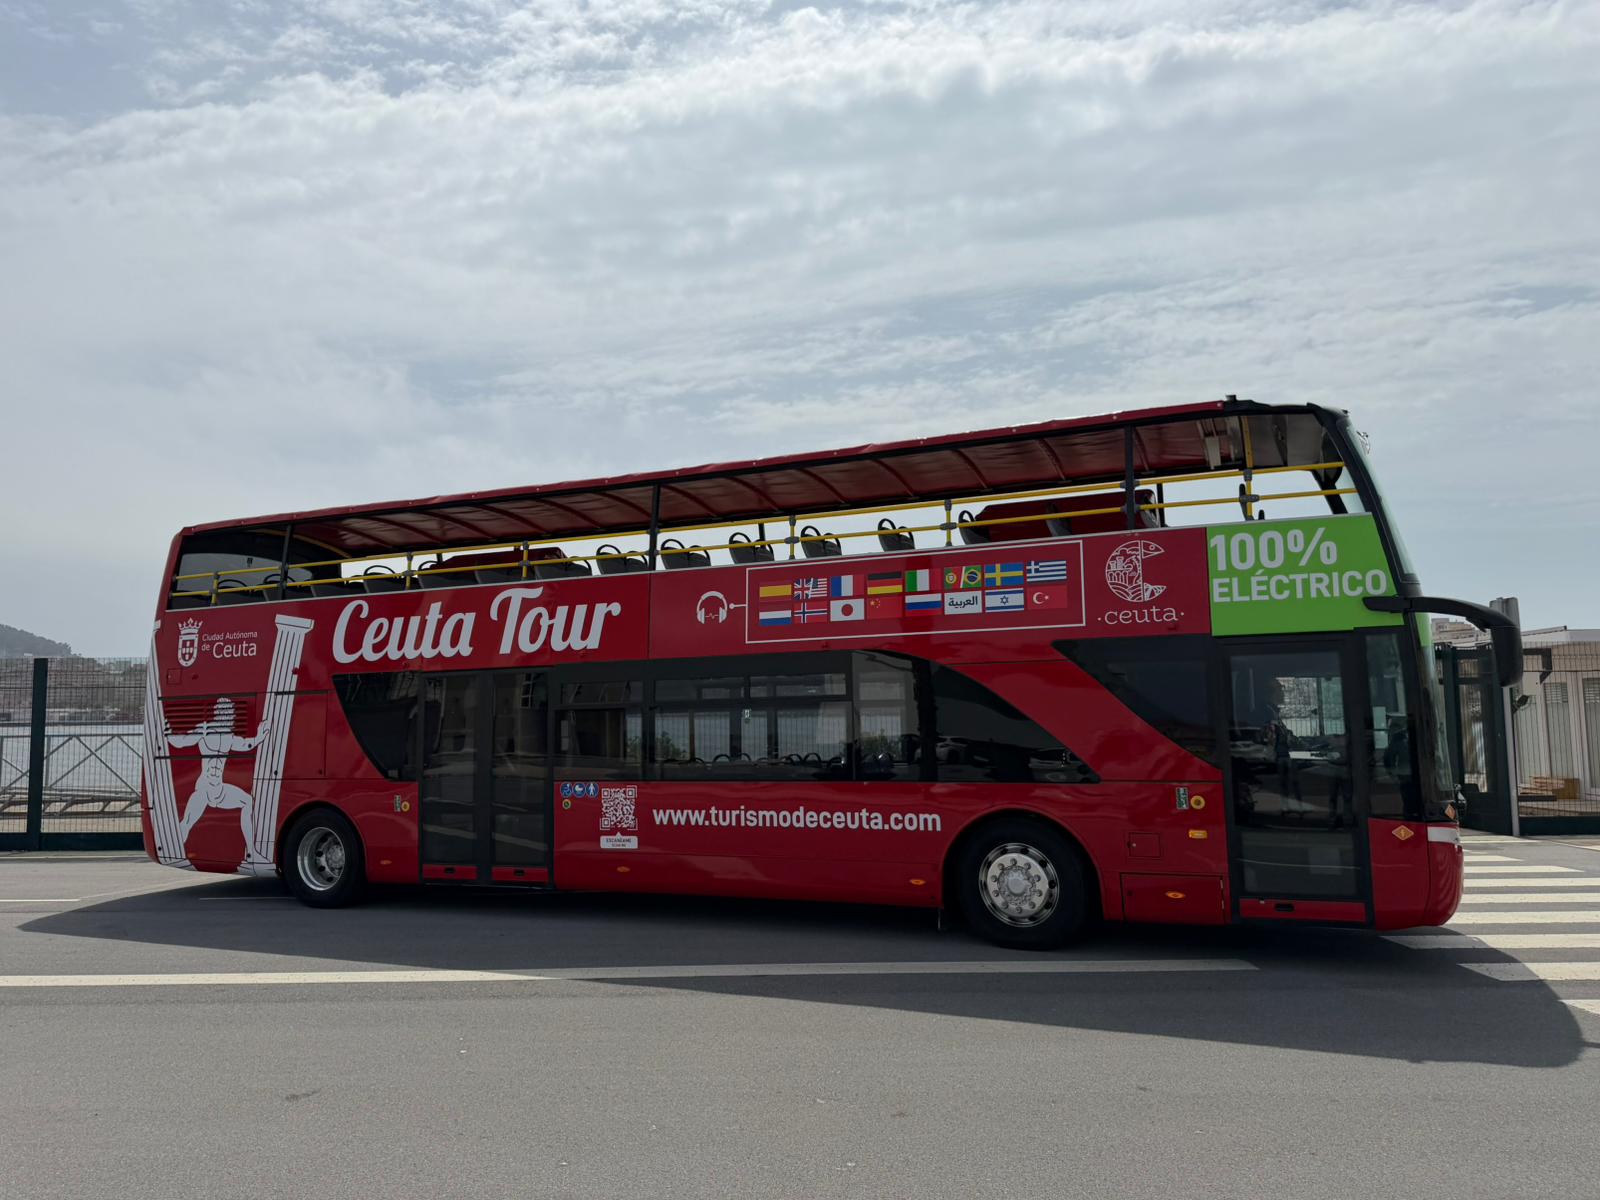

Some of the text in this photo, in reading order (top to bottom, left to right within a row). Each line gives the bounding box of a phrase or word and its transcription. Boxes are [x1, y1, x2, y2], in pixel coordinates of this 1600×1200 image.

[1210, 527, 1338, 571] 100%
[1212, 569, 1388, 603] ELÉCTRICO
[948, 595, 978, 609] العربية
[202, 630, 258, 642] Ciudad Autónoma
[332, 586, 621, 664] Ceuta Tour
[201, 641, 257, 659] de Ceuta
[652, 805, 941, 832] www.turismodeceuta.com
